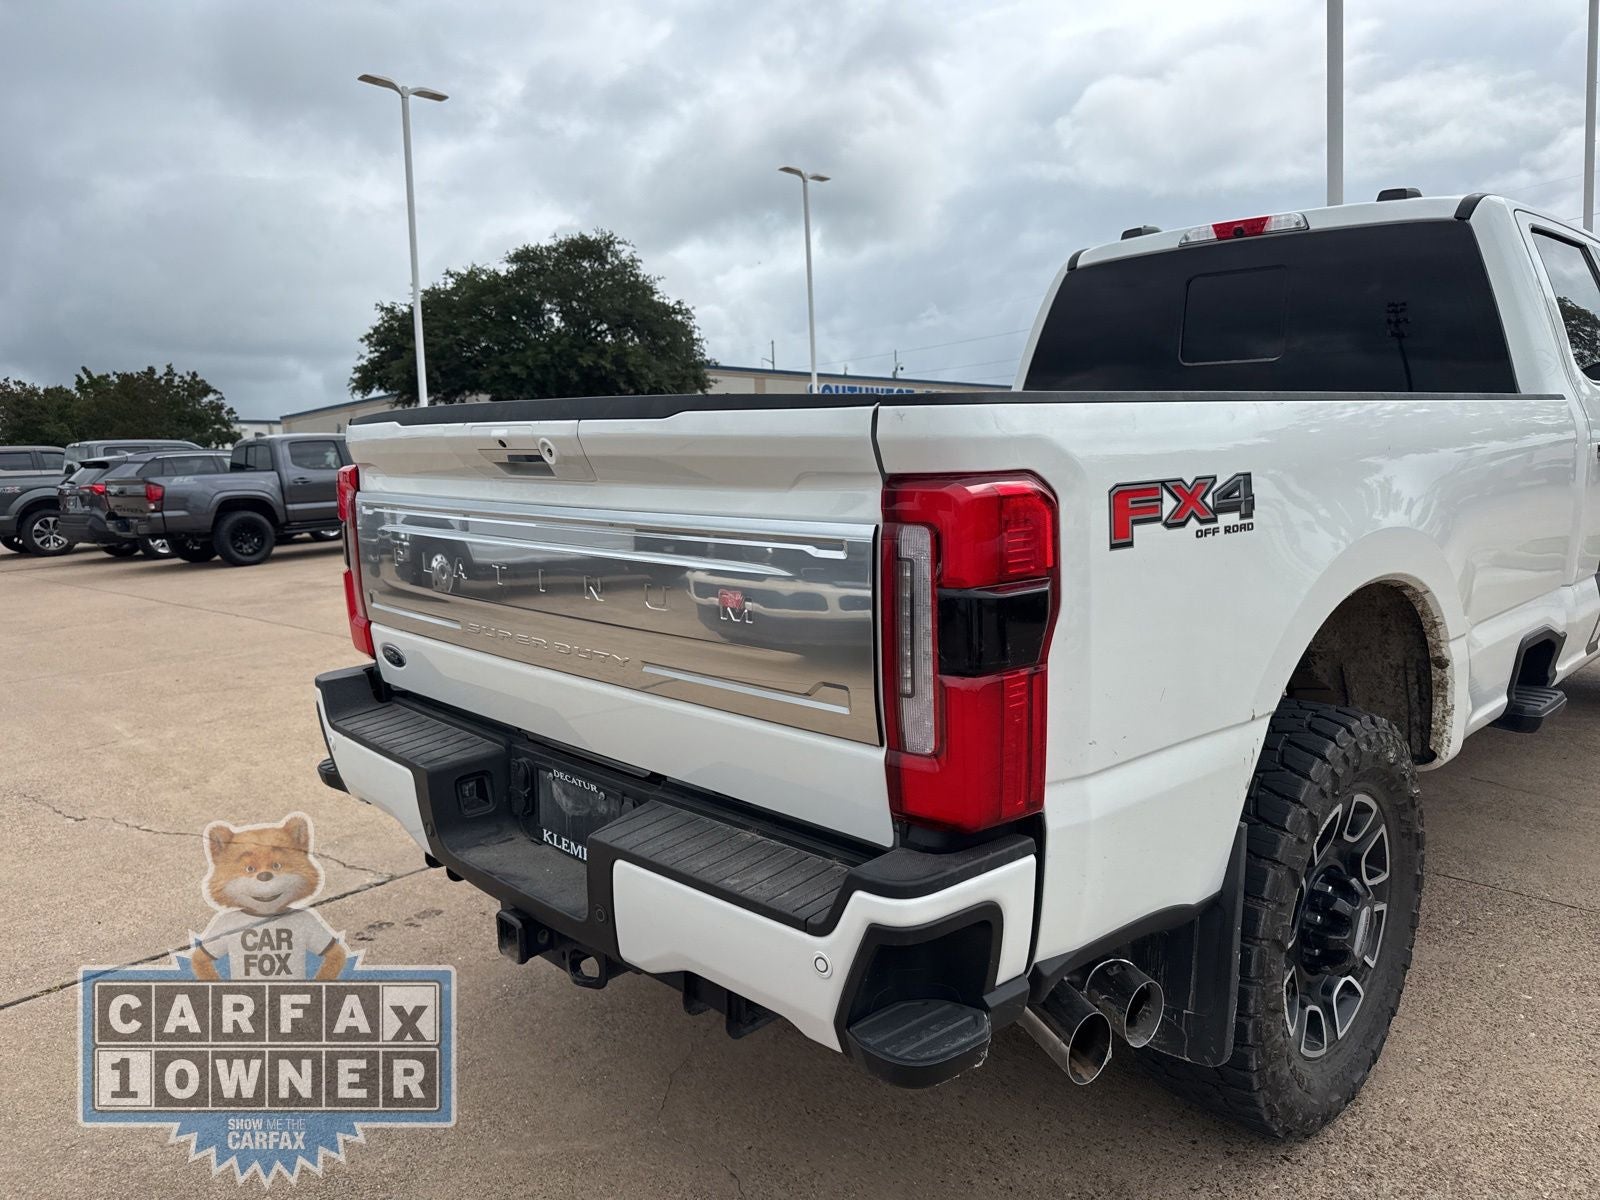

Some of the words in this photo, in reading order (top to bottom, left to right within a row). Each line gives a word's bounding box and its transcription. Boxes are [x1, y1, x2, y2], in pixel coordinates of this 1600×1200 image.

[1109, 472, 1254, 551] FX4
[1195, 527, 1220, 539] OFF
[1223, 522, 1254, 535] ROAD
[393, 546, 753, 624] PLATINUM
[467, 622, 549, 650] SUPER
[553, 641, 630, 667] DUTY
[552, 769, 599, 793] DECATUR
